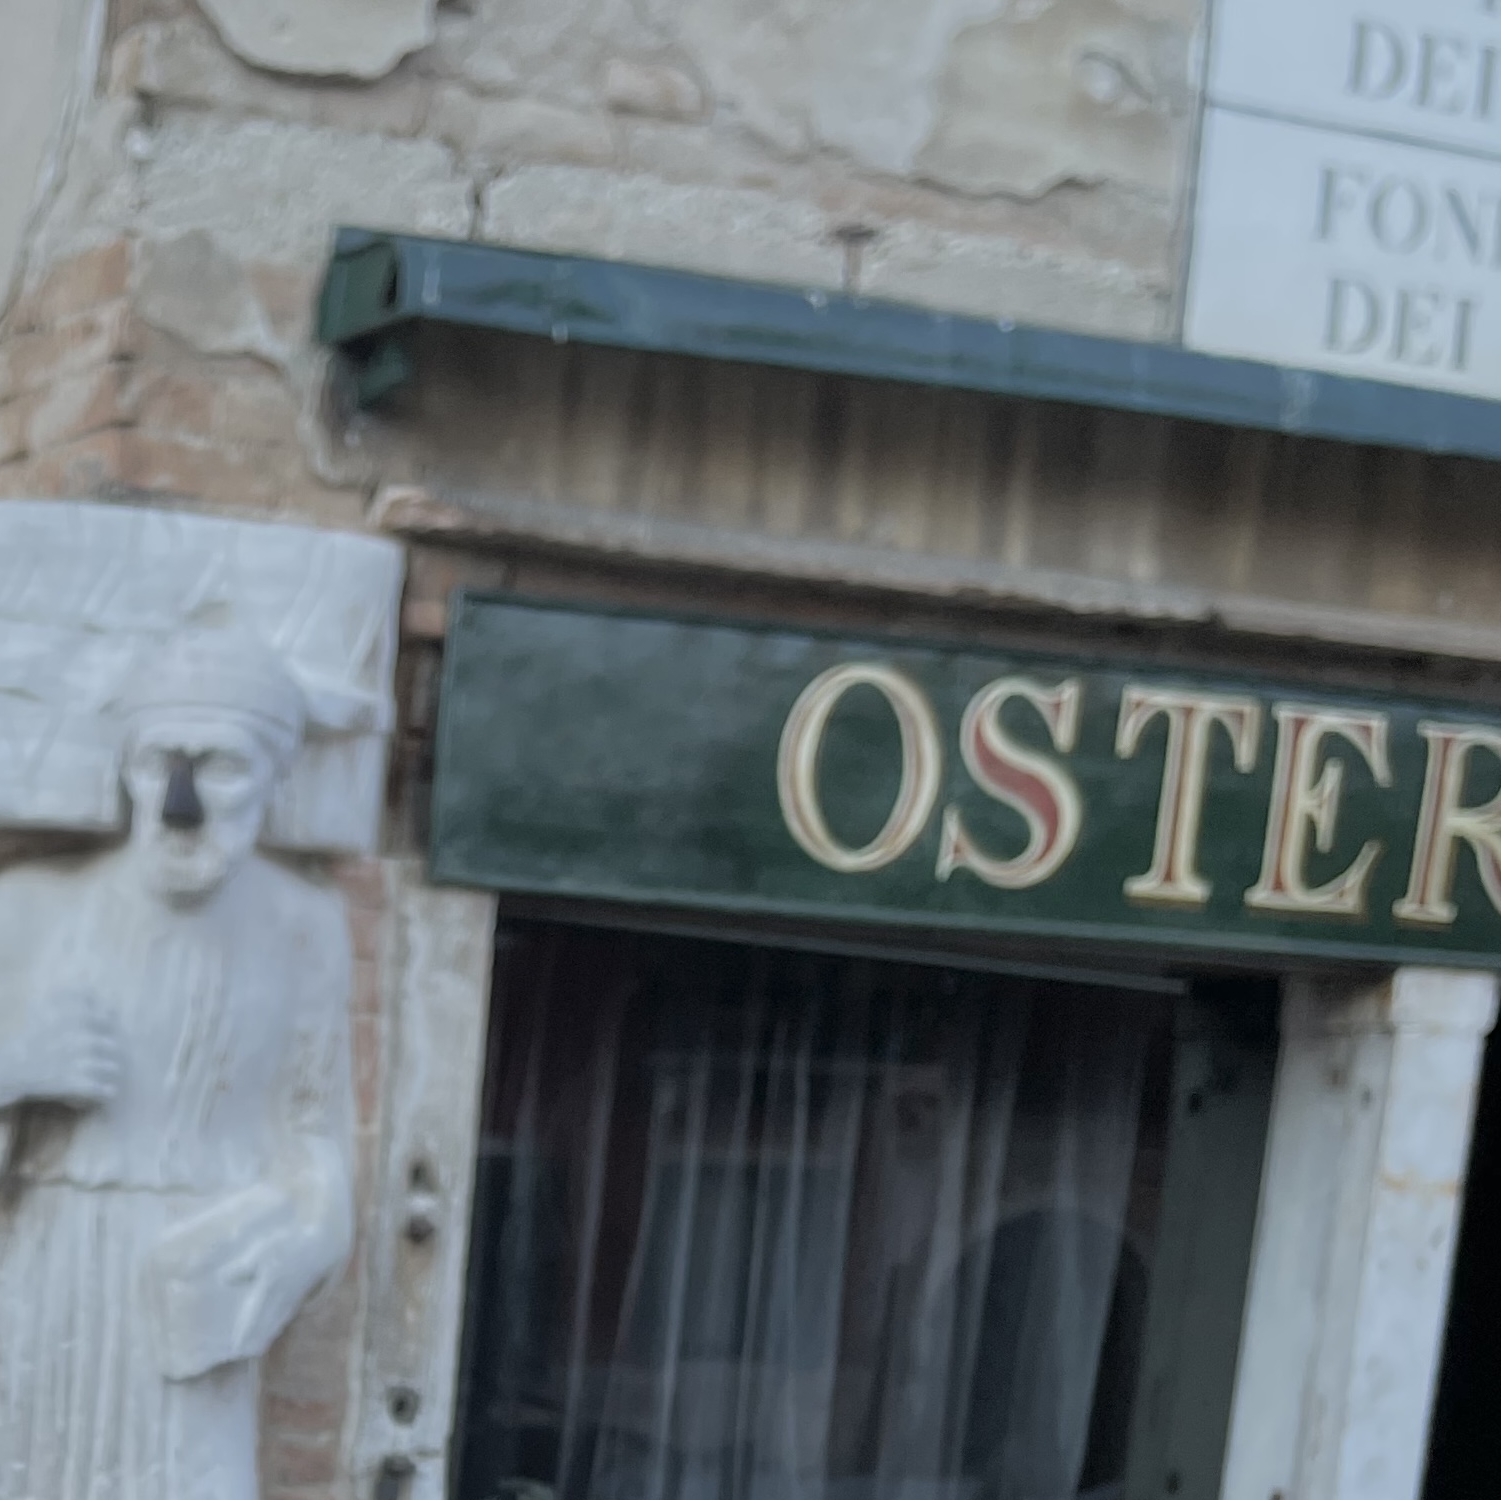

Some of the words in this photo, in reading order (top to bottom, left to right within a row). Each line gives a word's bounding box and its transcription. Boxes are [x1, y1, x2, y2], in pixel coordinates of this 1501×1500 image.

[1313, 164, 1500, 270] FON
[1325, 275, 1480, 372] DEI
[776, 661, 1500, 924] OSTER
